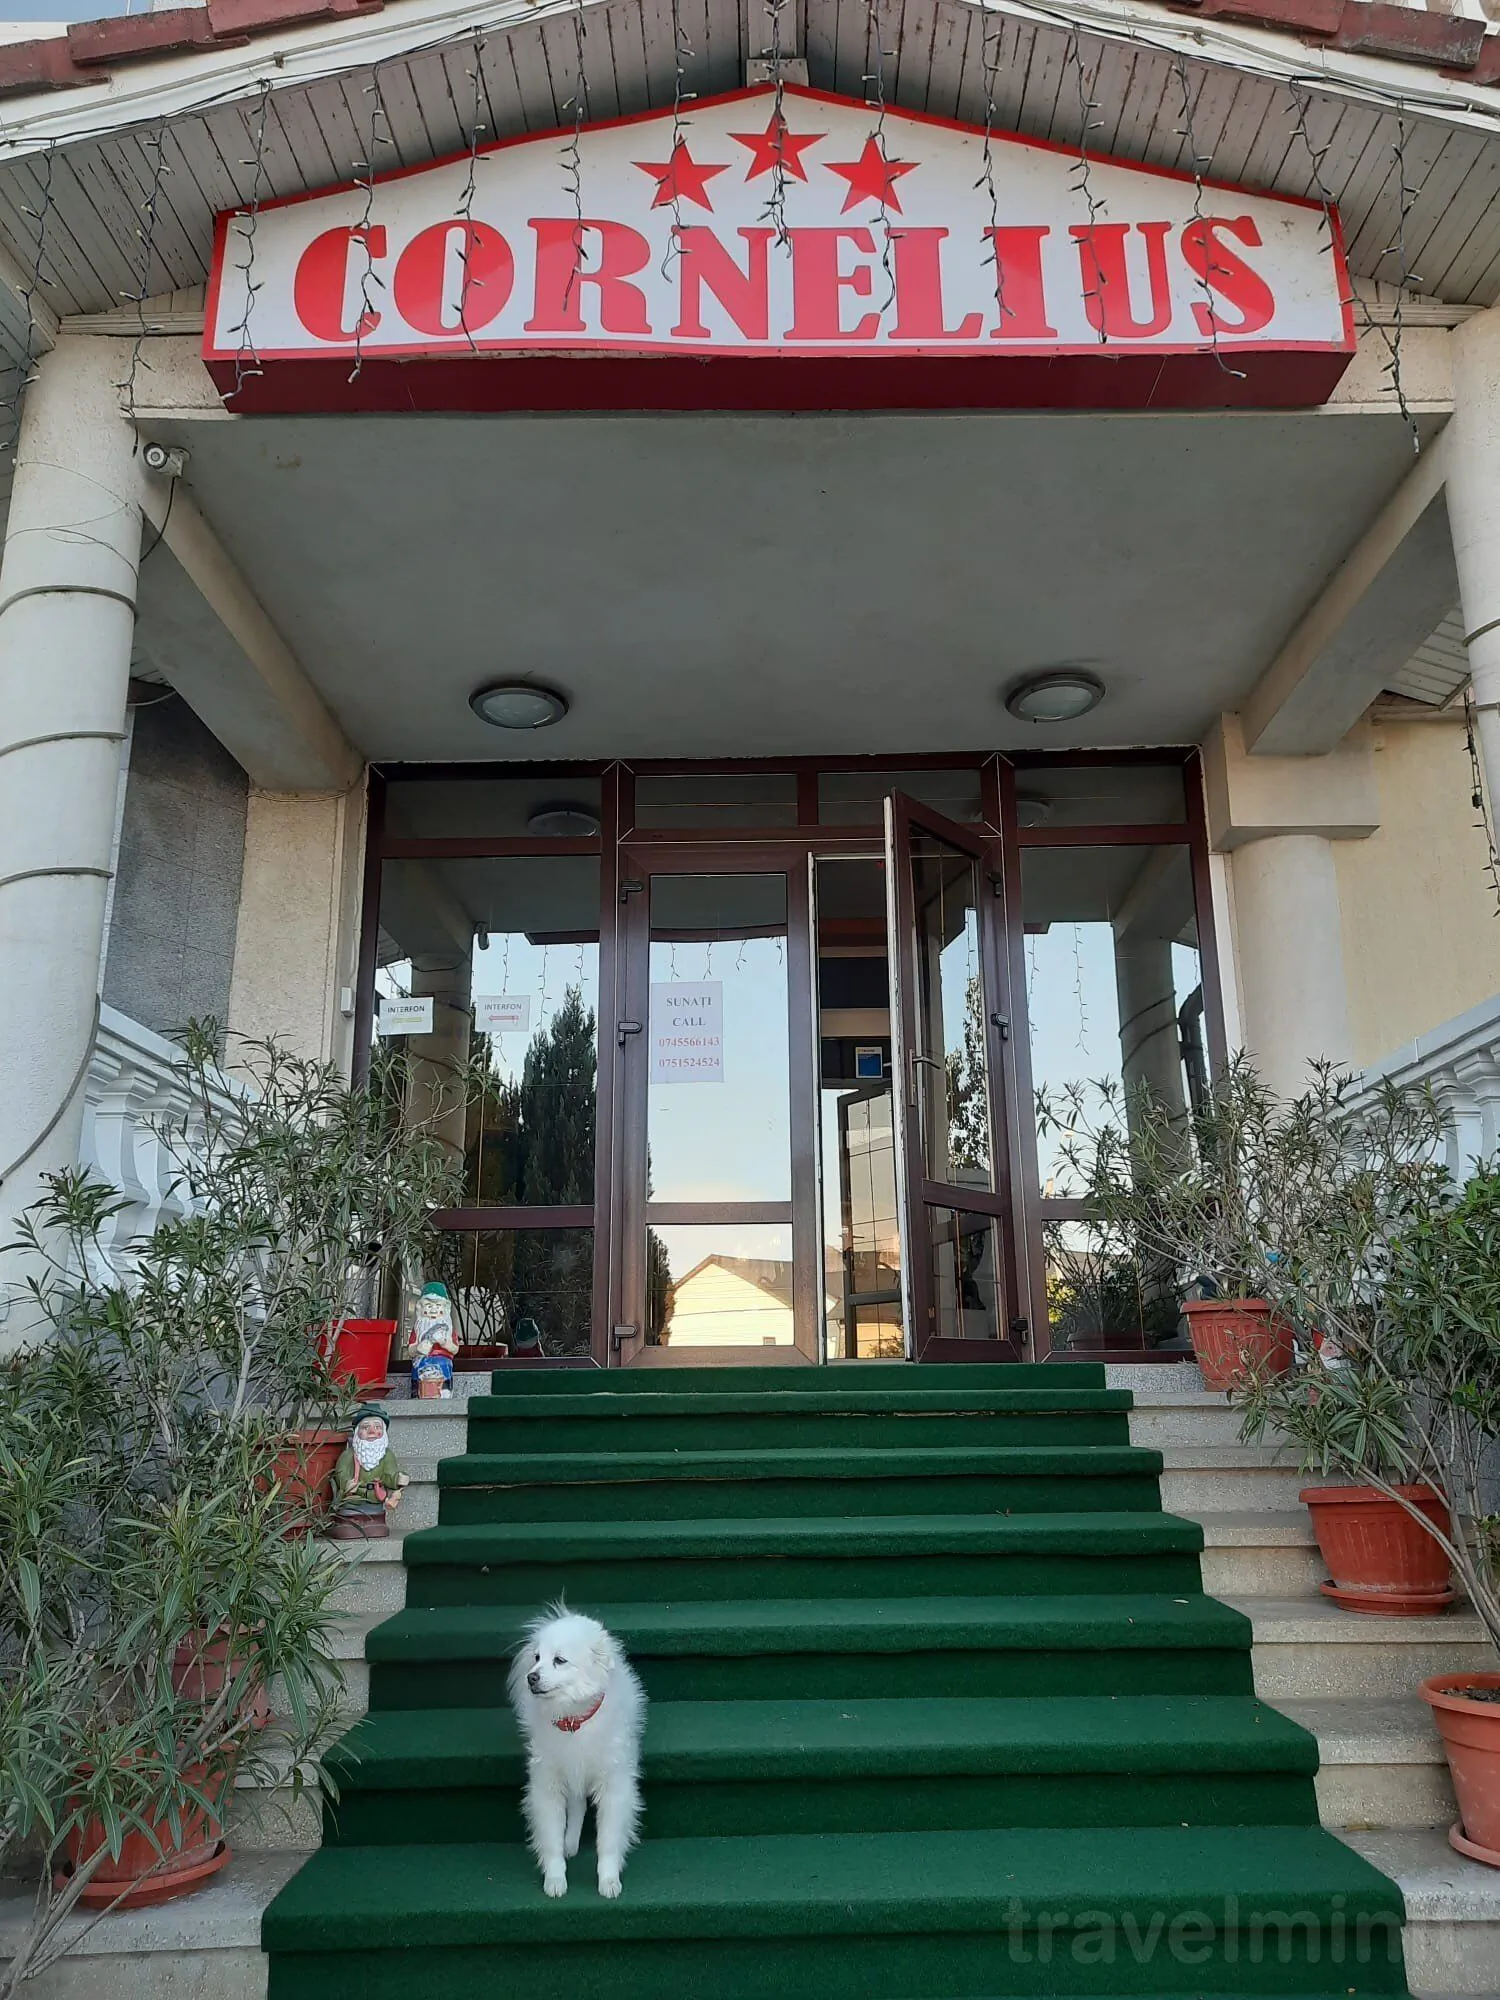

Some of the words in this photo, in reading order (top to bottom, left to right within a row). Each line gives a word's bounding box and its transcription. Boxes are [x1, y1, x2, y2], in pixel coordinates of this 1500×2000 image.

[294, 216, 1276, 342] CORNELIUS
[387, 1005, 425, 1014] INTERFON
[484, 1003, 522, 1011] INTERFON
[672, 1017, 706, 1027] CALL
[658, 1037, 720, 1048] 0745566143
[658, 1057, 720, 1068] 0751524524
